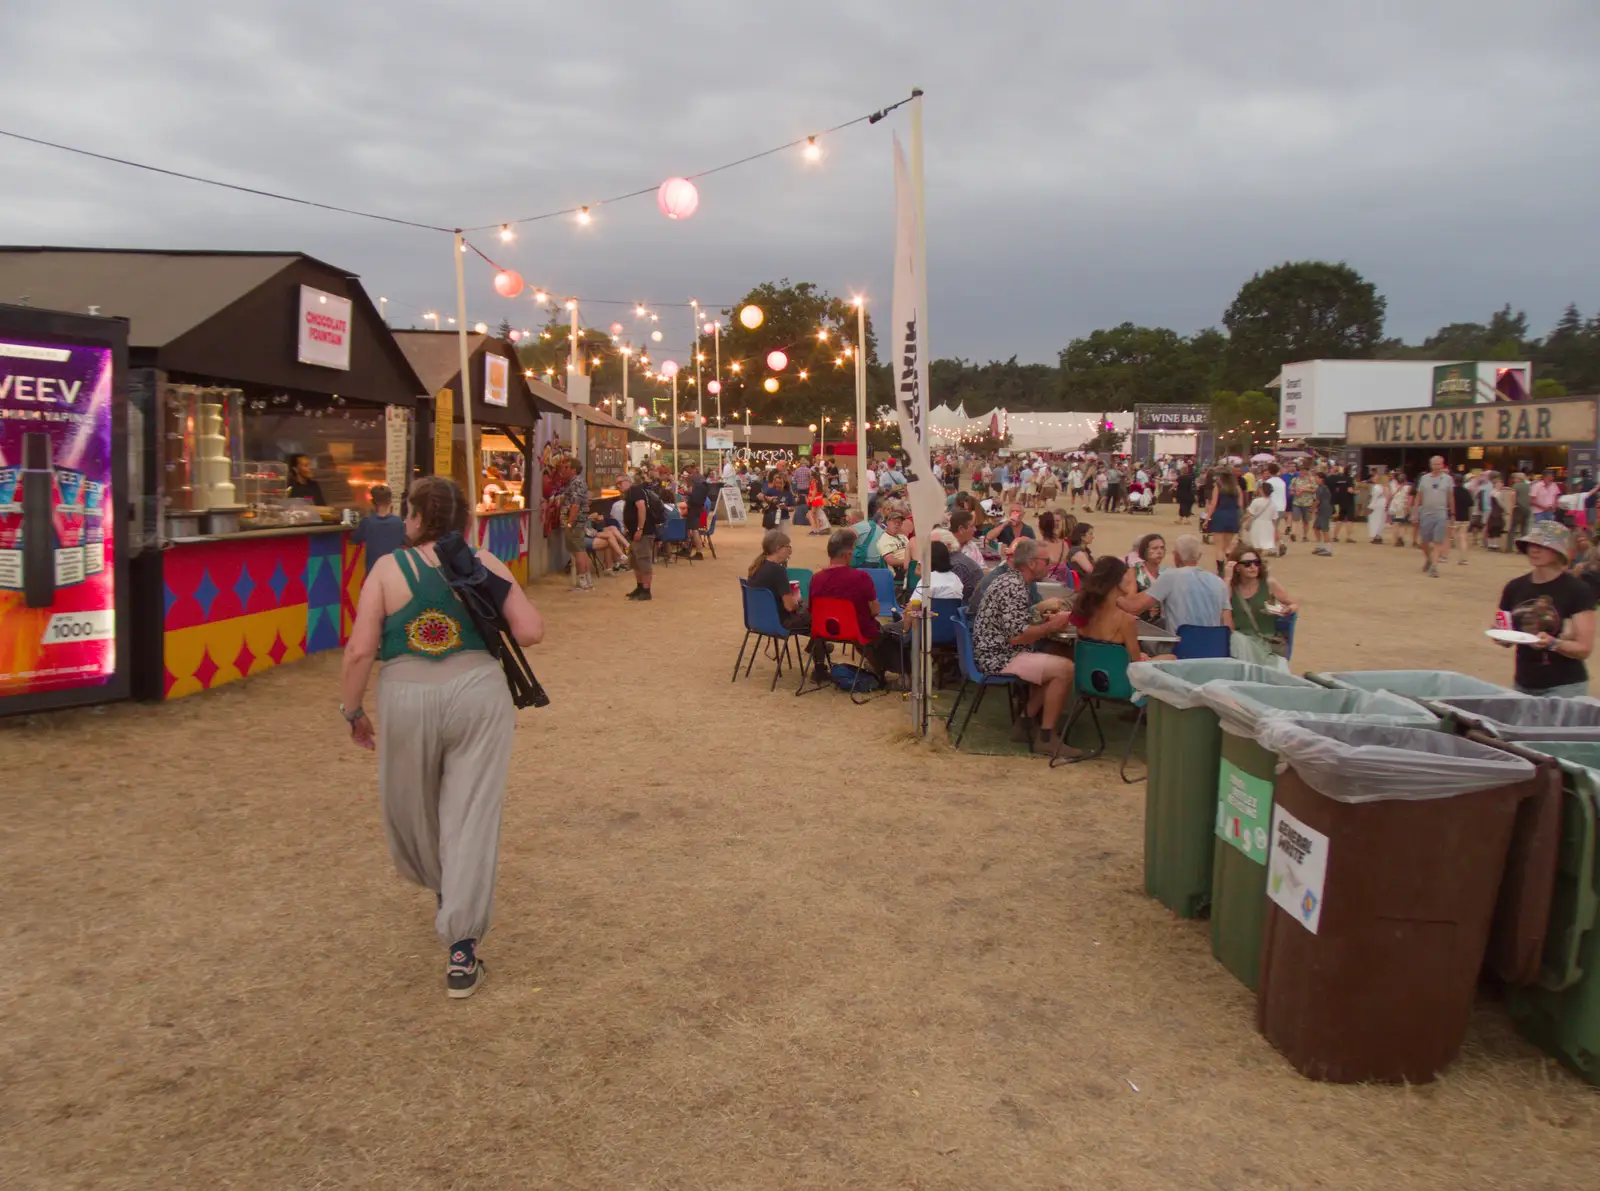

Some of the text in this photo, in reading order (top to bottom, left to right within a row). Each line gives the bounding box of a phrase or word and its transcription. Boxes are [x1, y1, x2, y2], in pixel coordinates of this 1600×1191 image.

[306, 311, 347, 333] CHOCOLATE
[309, 327, 342, 346] FOUNTAIN
[1151, 413, 1204, 423] WINE BAR
[1373, 407, 1552, 441] WELCOME BAR
[52, 622, 93, 638] 1000
[1278, 819, 1313, 855] GENERAL
[1277, 834, 1306, 866] WASTE
